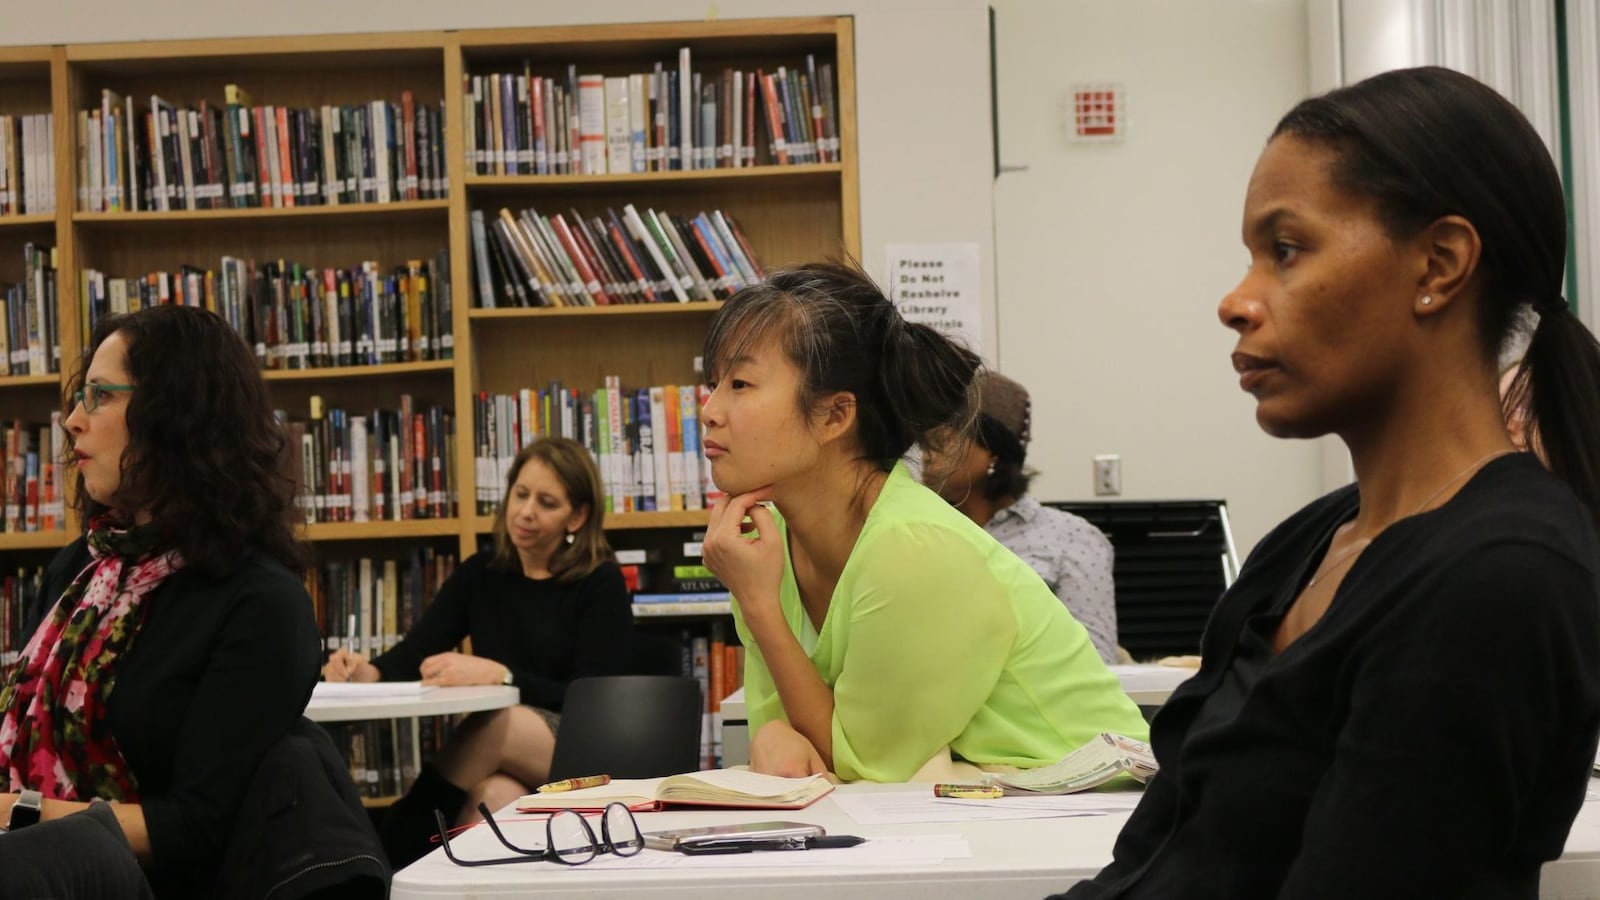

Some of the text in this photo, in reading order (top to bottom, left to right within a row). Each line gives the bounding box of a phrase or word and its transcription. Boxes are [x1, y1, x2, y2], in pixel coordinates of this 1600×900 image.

[900, 260, 943, 268] Please
[900, 275, 944, 283] Do Not
[901, 290, 960, 298] Reshelve
[901, 306, 947, 315] Library
